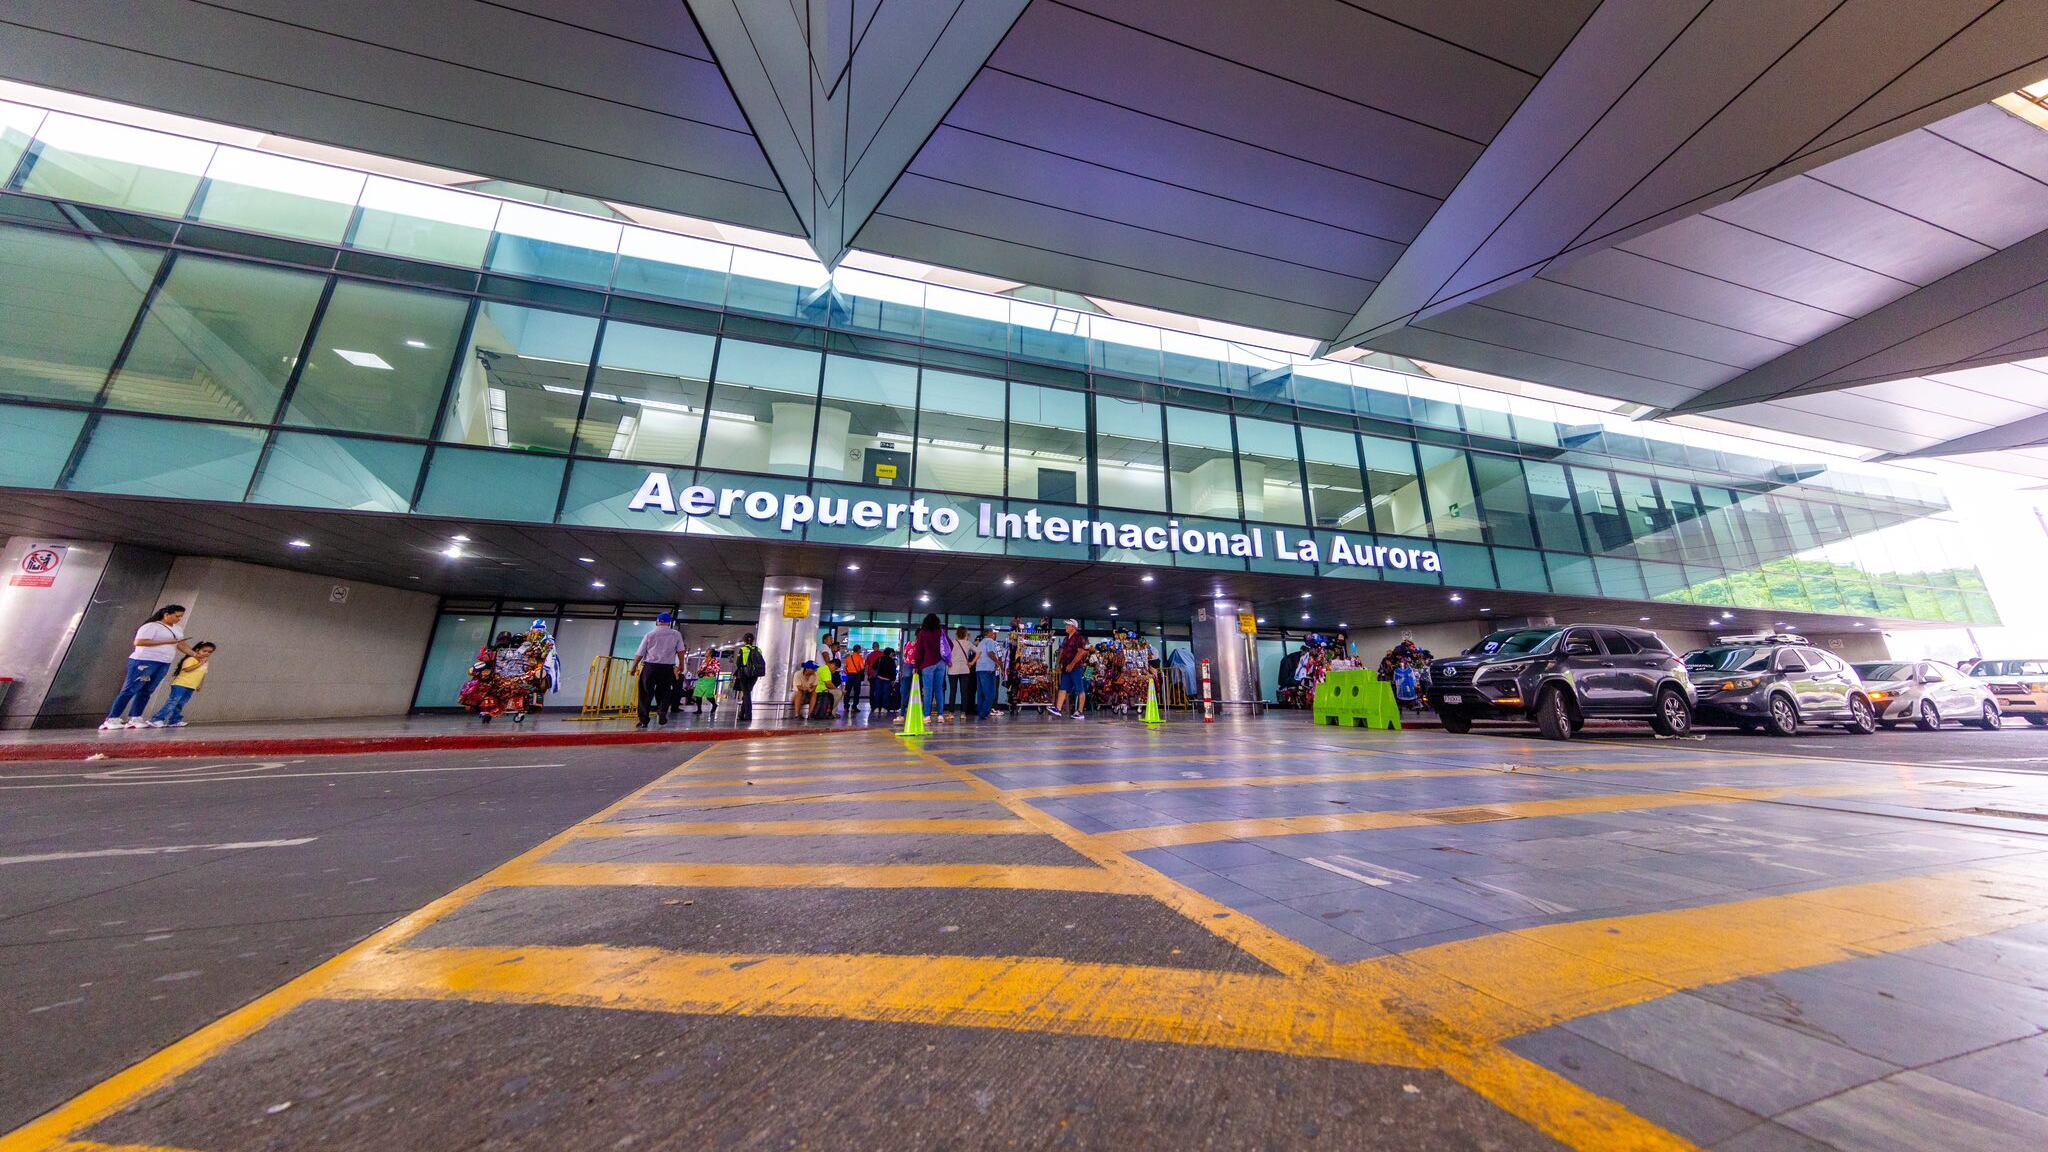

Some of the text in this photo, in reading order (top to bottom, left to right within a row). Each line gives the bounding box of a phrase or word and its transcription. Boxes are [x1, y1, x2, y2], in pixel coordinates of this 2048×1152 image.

[628, 472, 1441, 572] Aeropuerto Internacional La Aurora
